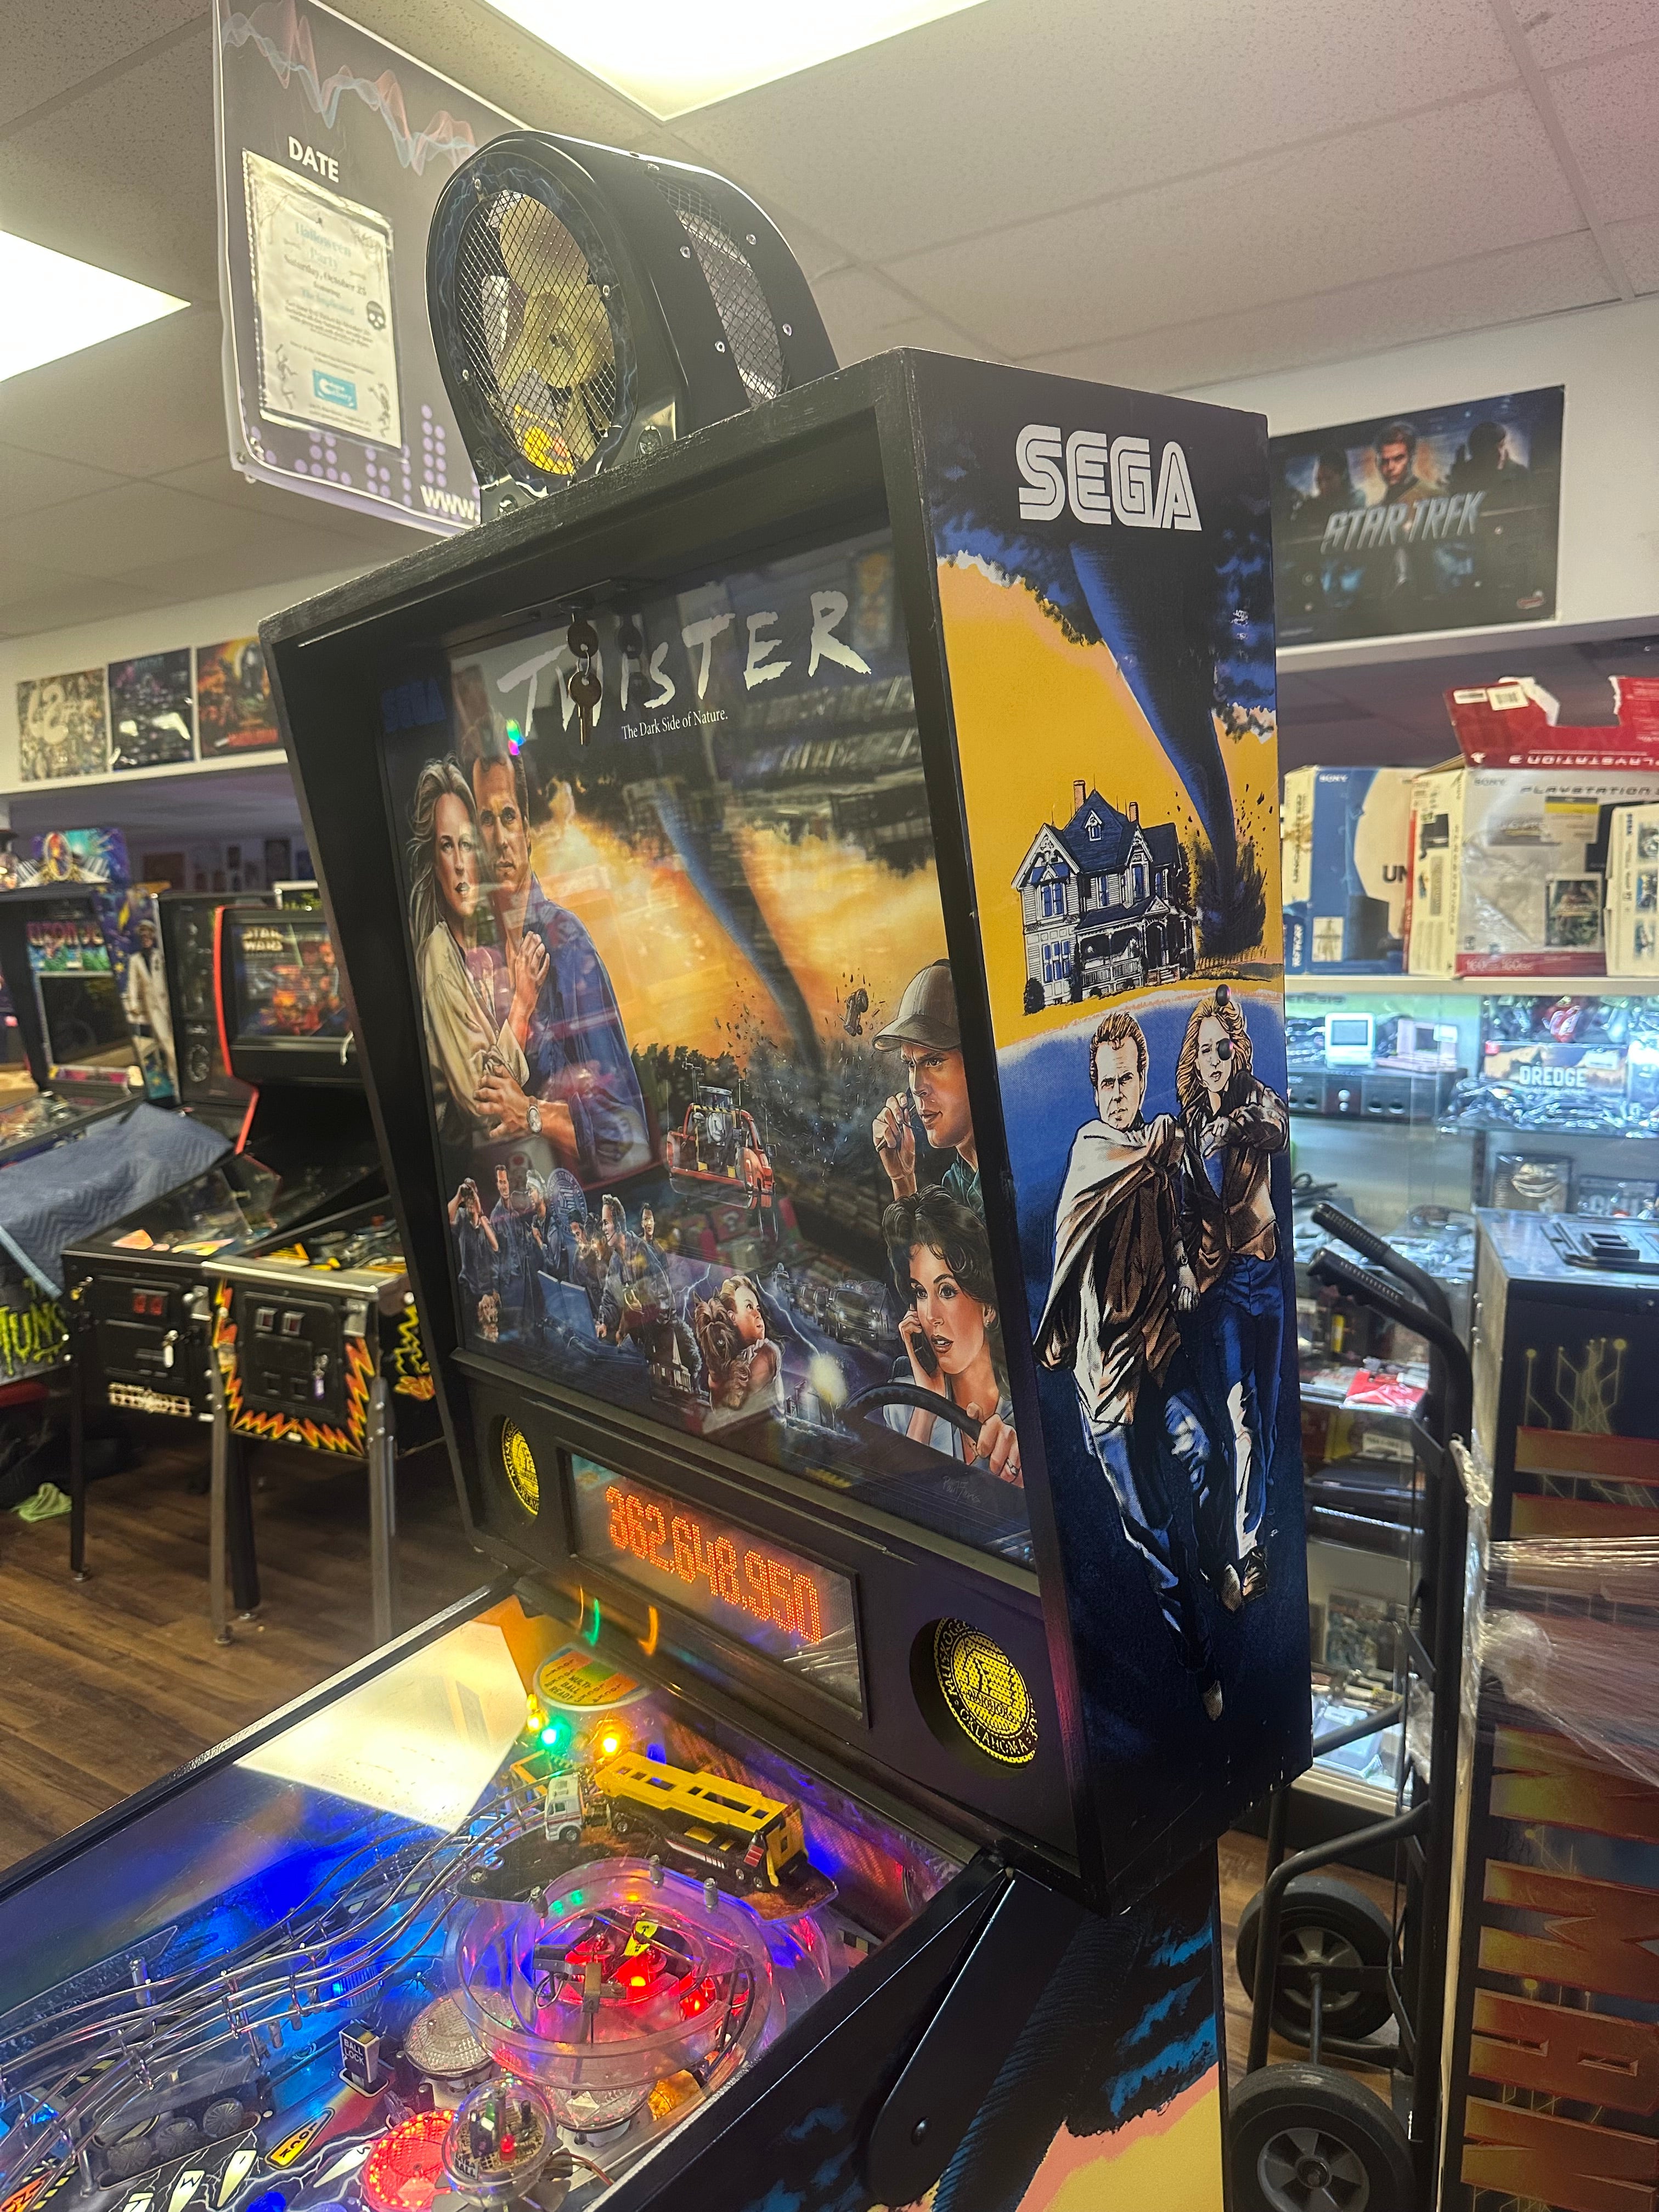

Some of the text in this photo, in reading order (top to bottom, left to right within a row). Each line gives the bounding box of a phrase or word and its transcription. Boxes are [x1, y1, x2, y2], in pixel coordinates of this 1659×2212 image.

[289, 136, 338, 183] DATE
[1015, 424, 1203, 532] SEGA
[1320, 490, 1487, 554] STAR TREK
[621, 709, 728, 740] The Dark Side of Nature.
[1319, 774, 1349, 783] SONY
[1474, 778, 1506, 786] SONY
[1520, 785, 1651, 795] PLAYSTATION
[1519, 1065, 1589, 1088] DREDGE
[549, 1686, 575, 1701] READY
[560, 1680, 580, 1695] BALL
[343, 2038, 363, 2057] BALL
[344, 2047, 365, 2066] LOCK
[279, 2123, 318, 2158] LOCK
